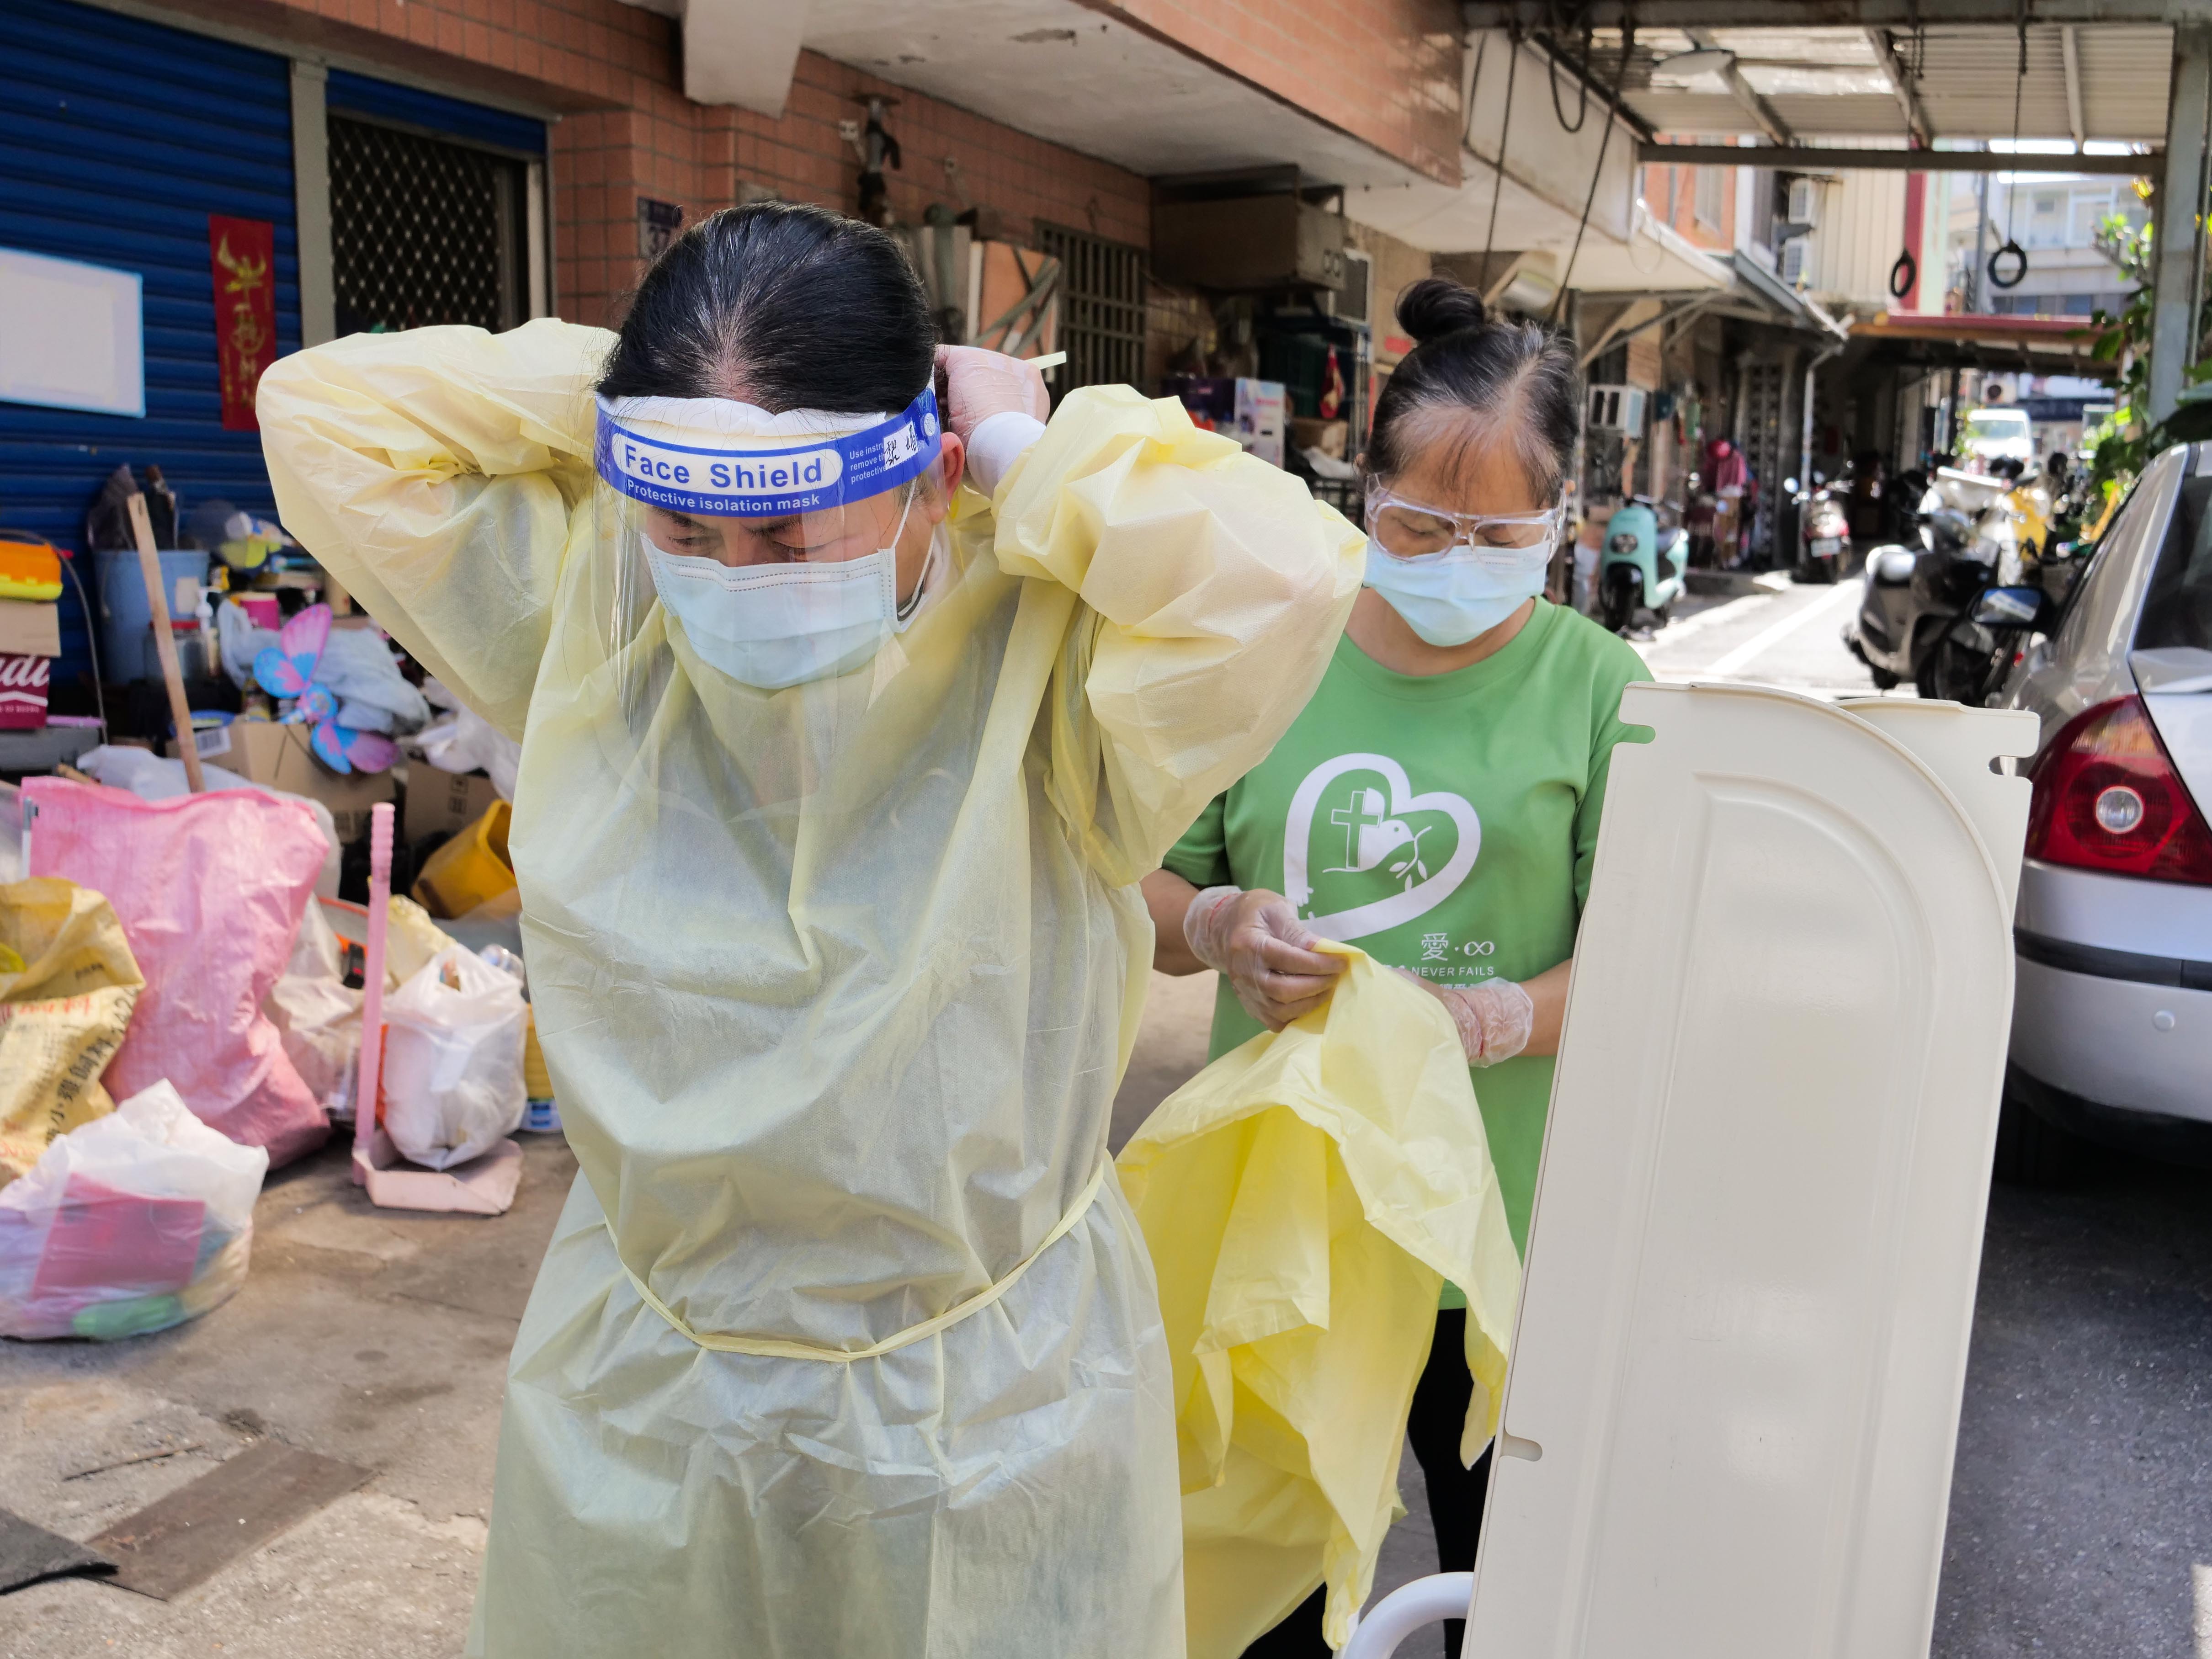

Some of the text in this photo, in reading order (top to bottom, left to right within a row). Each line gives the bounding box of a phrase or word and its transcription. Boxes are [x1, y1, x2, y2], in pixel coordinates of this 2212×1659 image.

[849, 450, 864, 460] Use
[850, 456, 877, 471] remove
[624, 443, 690, 484] Face
[710, 457, 822, 489] Shield
[851, 465, 886, 484] protective
[627, 479, 820, 511] Protective isolation mask
[1420, 932, 1448, 961] 愛
[1412, 966, 1455, 977] NEVER
[1459, 966, 1494, 976] FAILS
